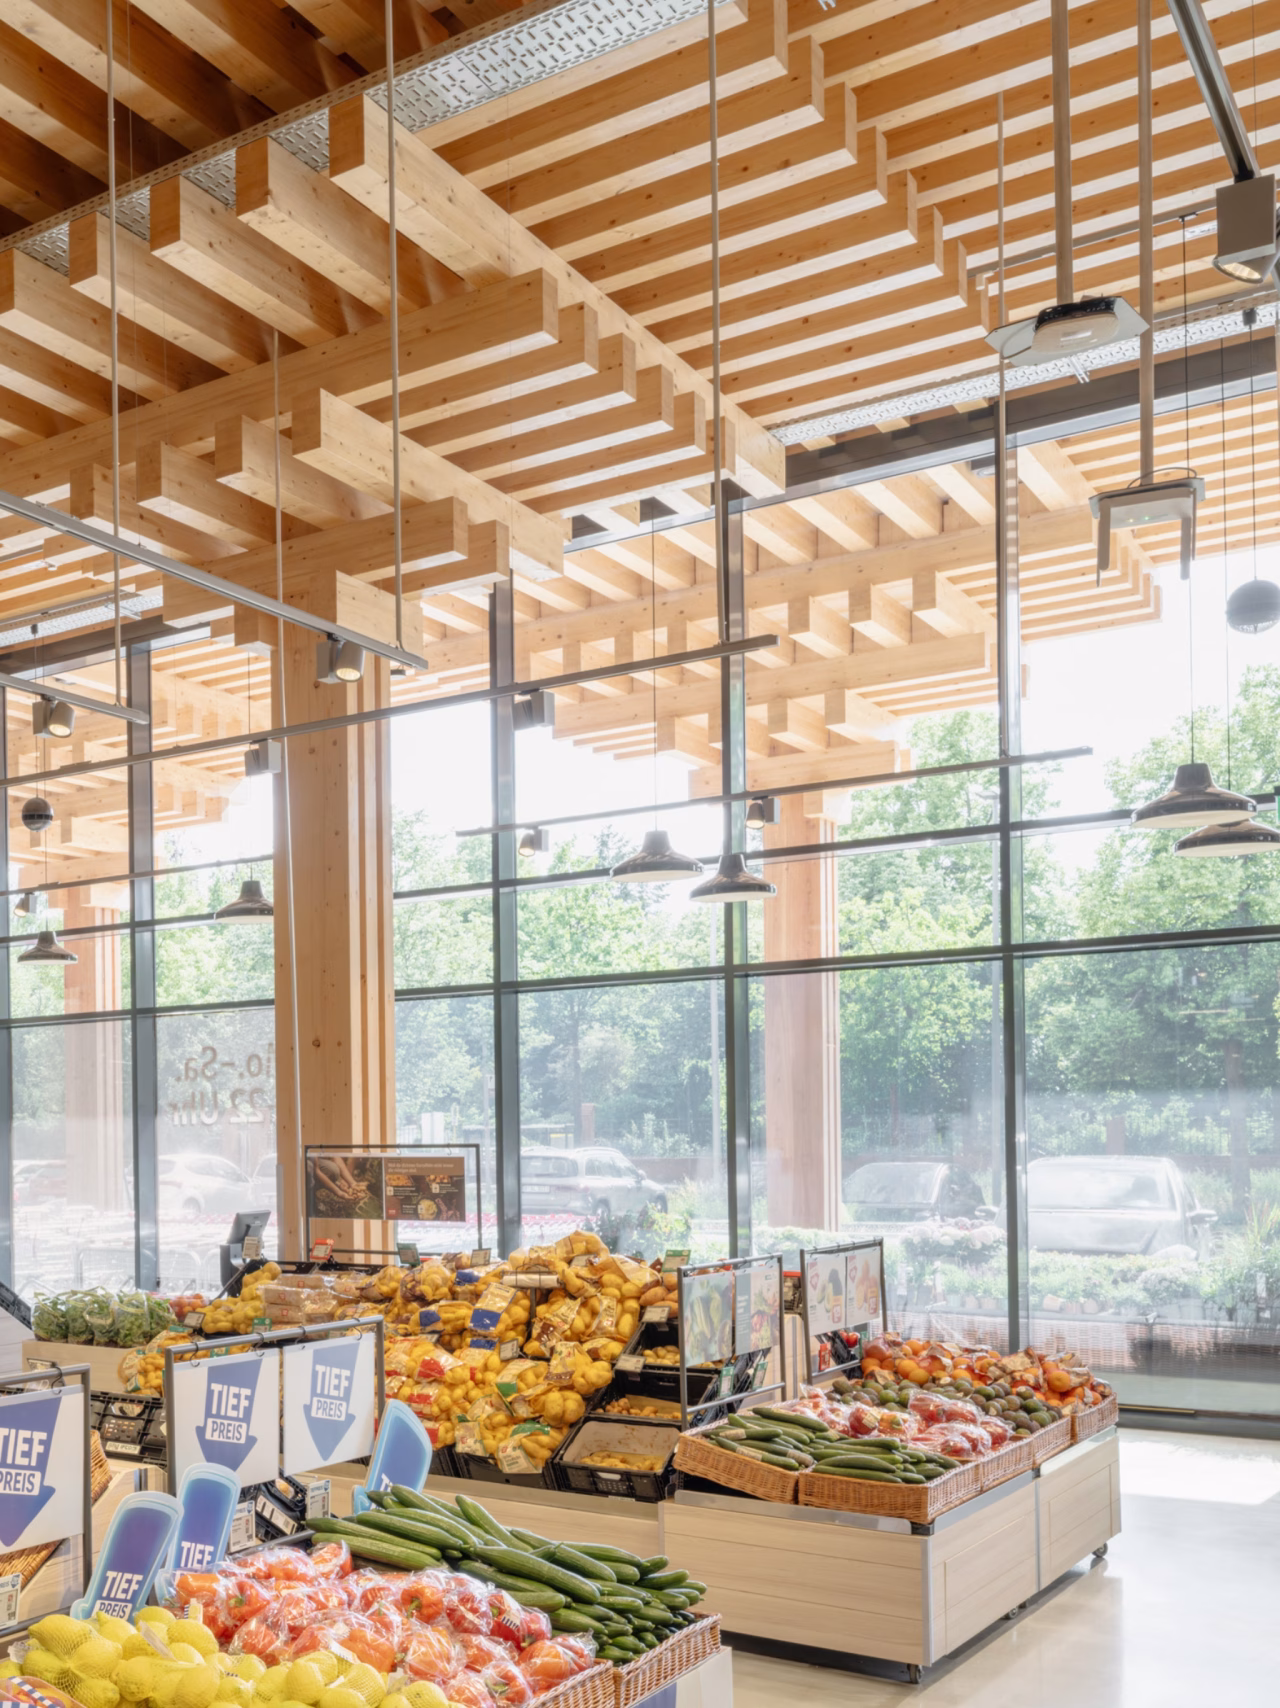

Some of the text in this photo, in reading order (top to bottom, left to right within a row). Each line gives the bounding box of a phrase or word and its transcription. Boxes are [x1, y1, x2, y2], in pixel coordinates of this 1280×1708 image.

[315, 1364, 350, 1397] TIEF
[211, 1383, 251, 1418] TIEF
[316, 1399, 343, 1419] PREIS
[211, 1420, 243, 1441] PREIS
[180, 1541, 215, 1569] TIEF
[102, 1571, 143, 1600] TIEF
